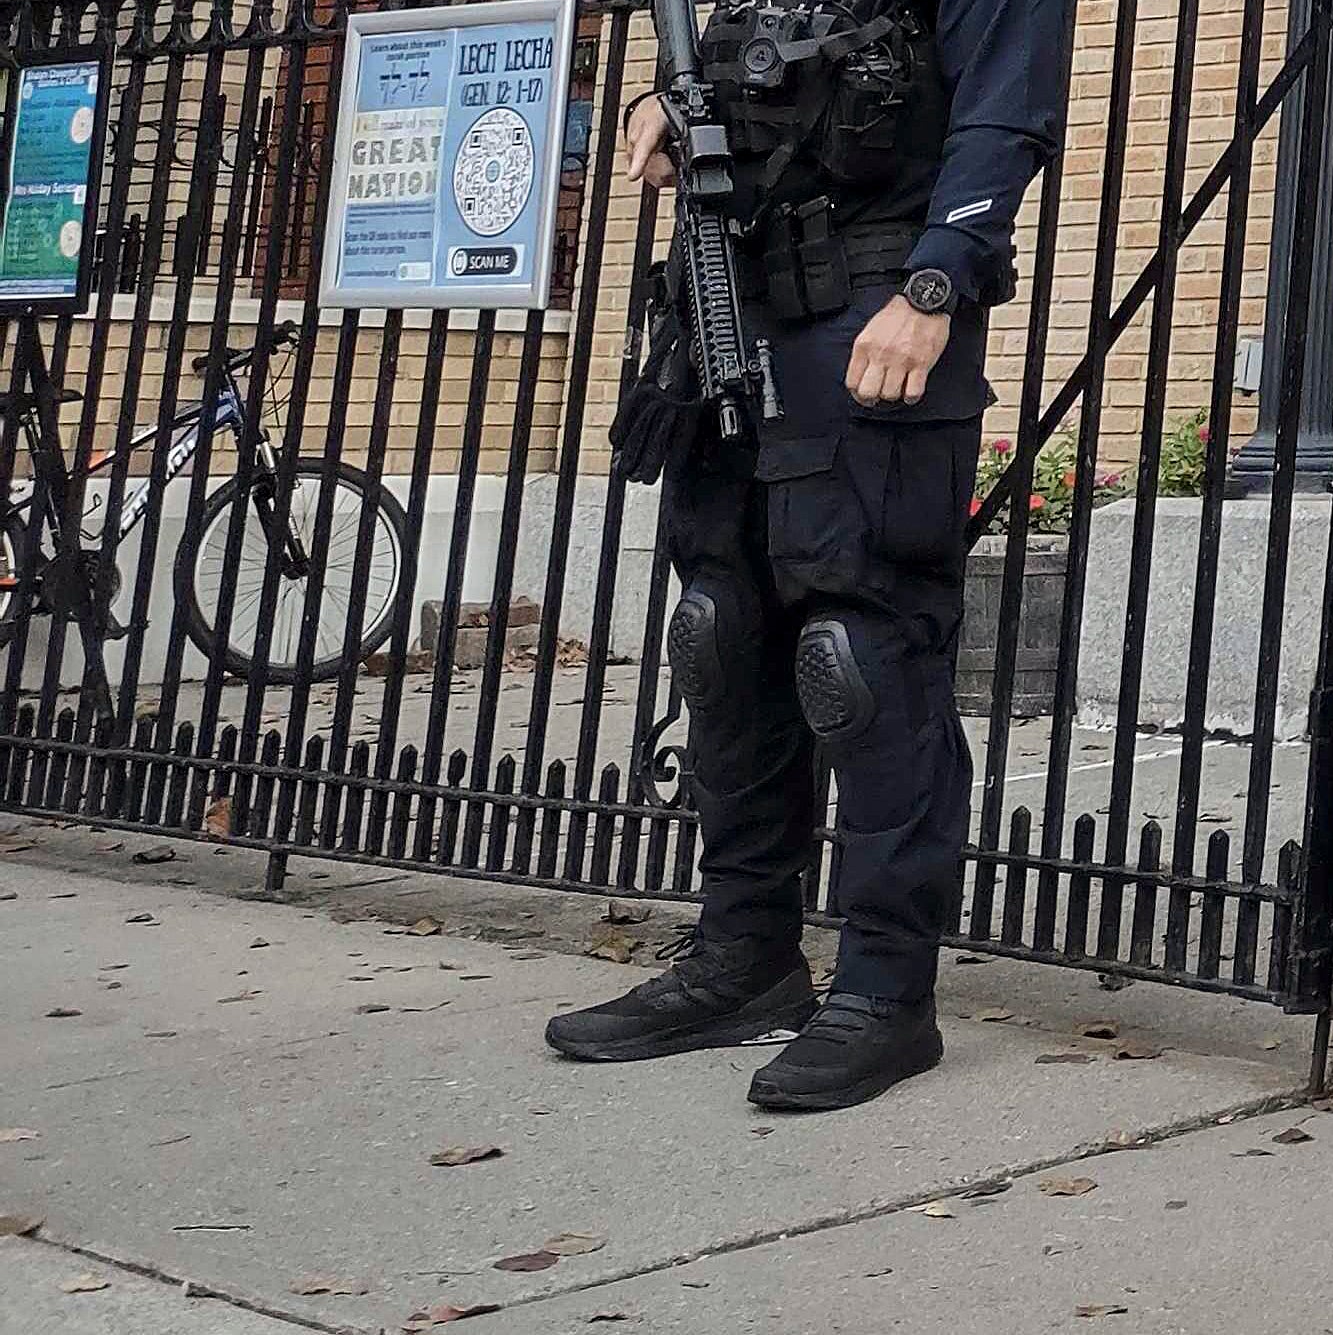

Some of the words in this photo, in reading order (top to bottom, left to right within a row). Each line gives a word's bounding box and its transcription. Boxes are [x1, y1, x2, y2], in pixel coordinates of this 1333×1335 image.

[458, 41, 497, 76] LECH
[504, 37, 553, 72] LECHA
[352, 135, 442, 166] GREAT
[347, 169, 438, 199] NATION
[468, 256, 494, 270] SCAN
[495, 254, 510, 268] ME
